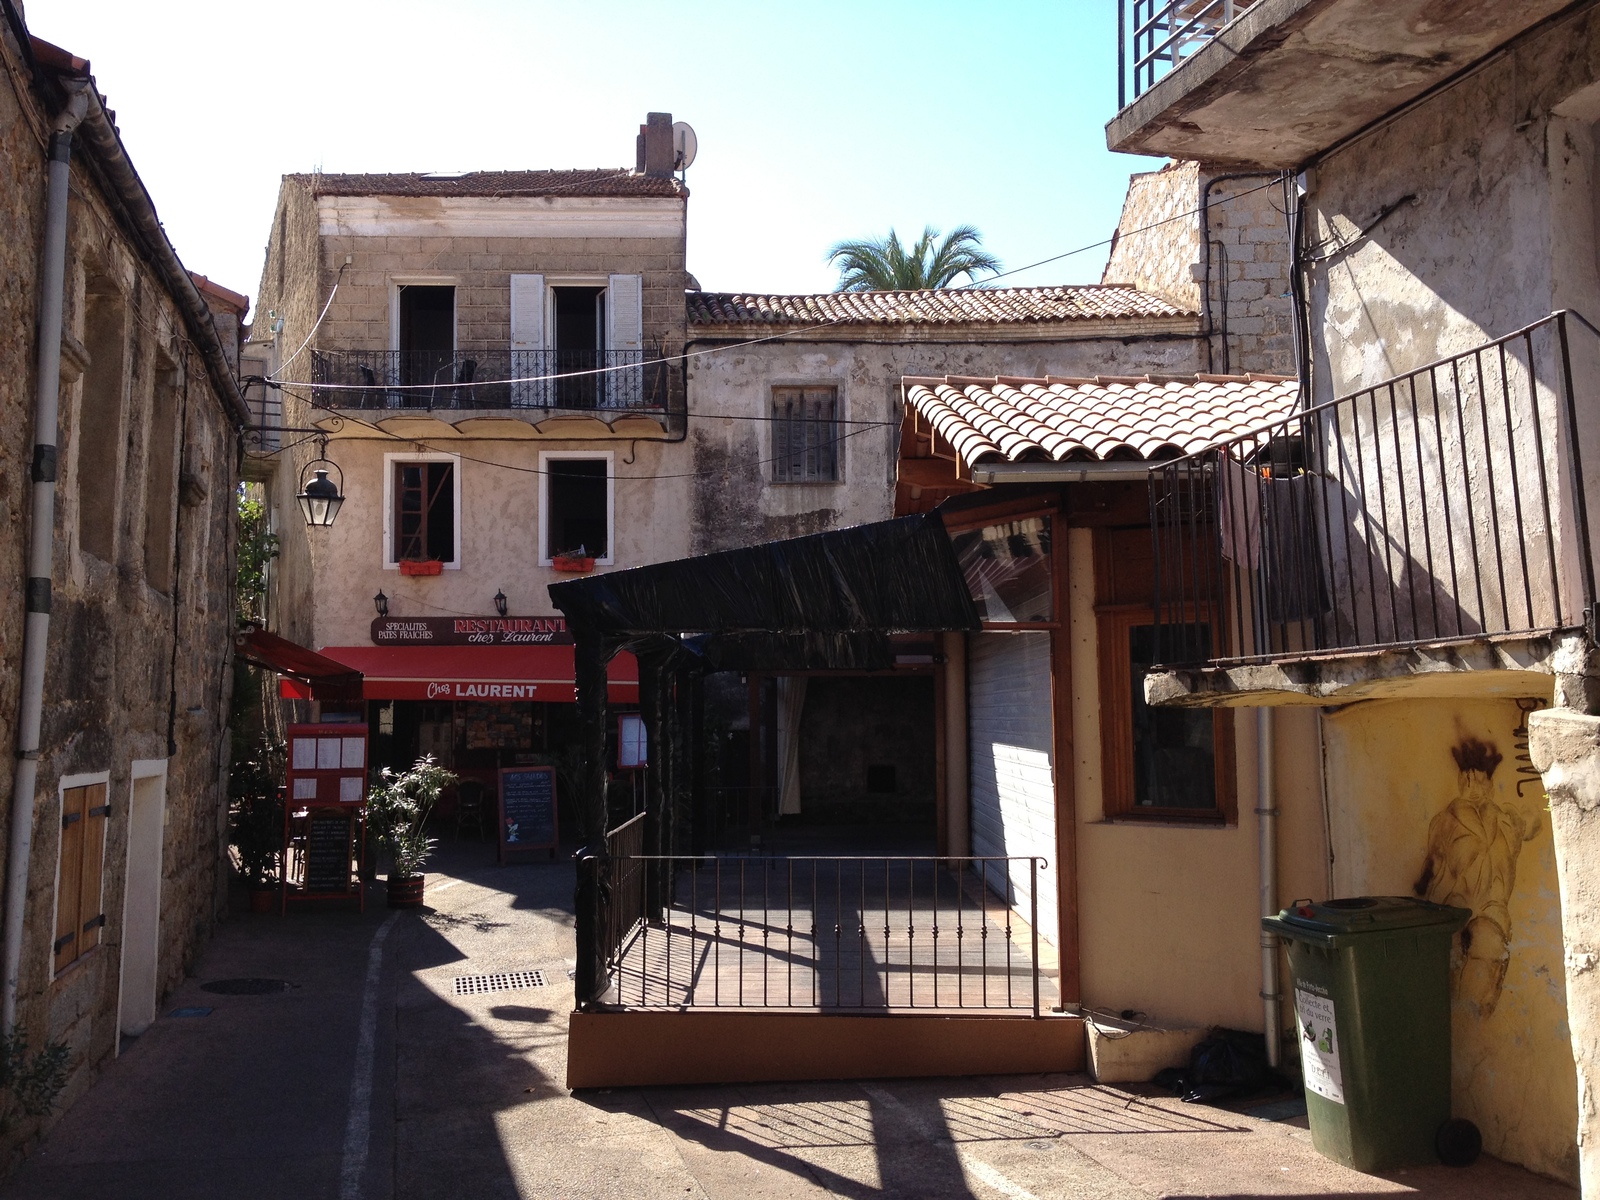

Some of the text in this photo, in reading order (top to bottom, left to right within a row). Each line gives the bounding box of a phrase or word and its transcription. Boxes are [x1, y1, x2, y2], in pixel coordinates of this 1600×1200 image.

[385, 622, 428, 631] SPECIALITES
[454, 619, 566, 633] RESTAURANT
[399, 630, 433, 639] FRAICHES
[468, 631, 553, 644] chez Laurent
[427, 682, 537, 699] Chez LAURENT
[1298, 994, 1321, 1010] Collecte
[1315, 1012, 1332, 1024] verre
